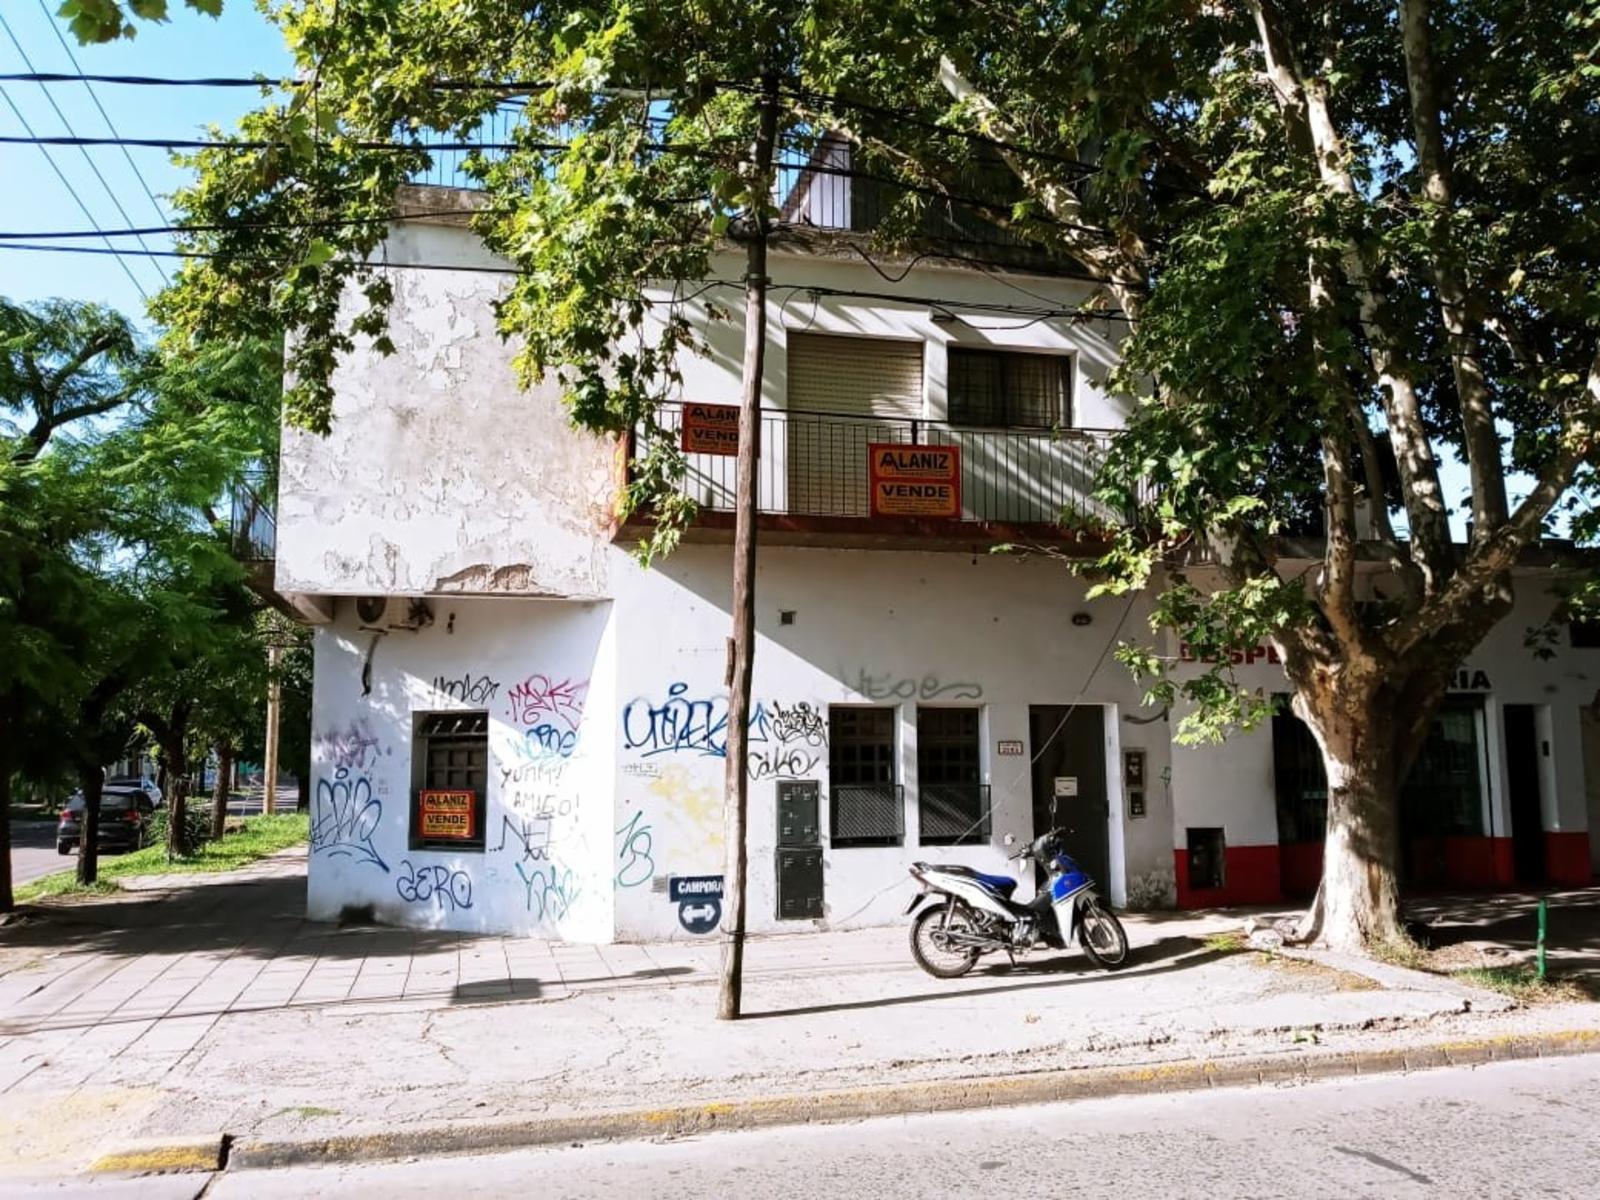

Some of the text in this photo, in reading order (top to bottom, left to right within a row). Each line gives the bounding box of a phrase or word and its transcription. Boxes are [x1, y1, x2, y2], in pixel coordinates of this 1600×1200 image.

[880, 451, 949, 471] ALANIZ
[881, 484, 950, 498] VENDE
[426, 794, 468, 806] ALANIZ
[427, 814, 467, 824] VENDE
